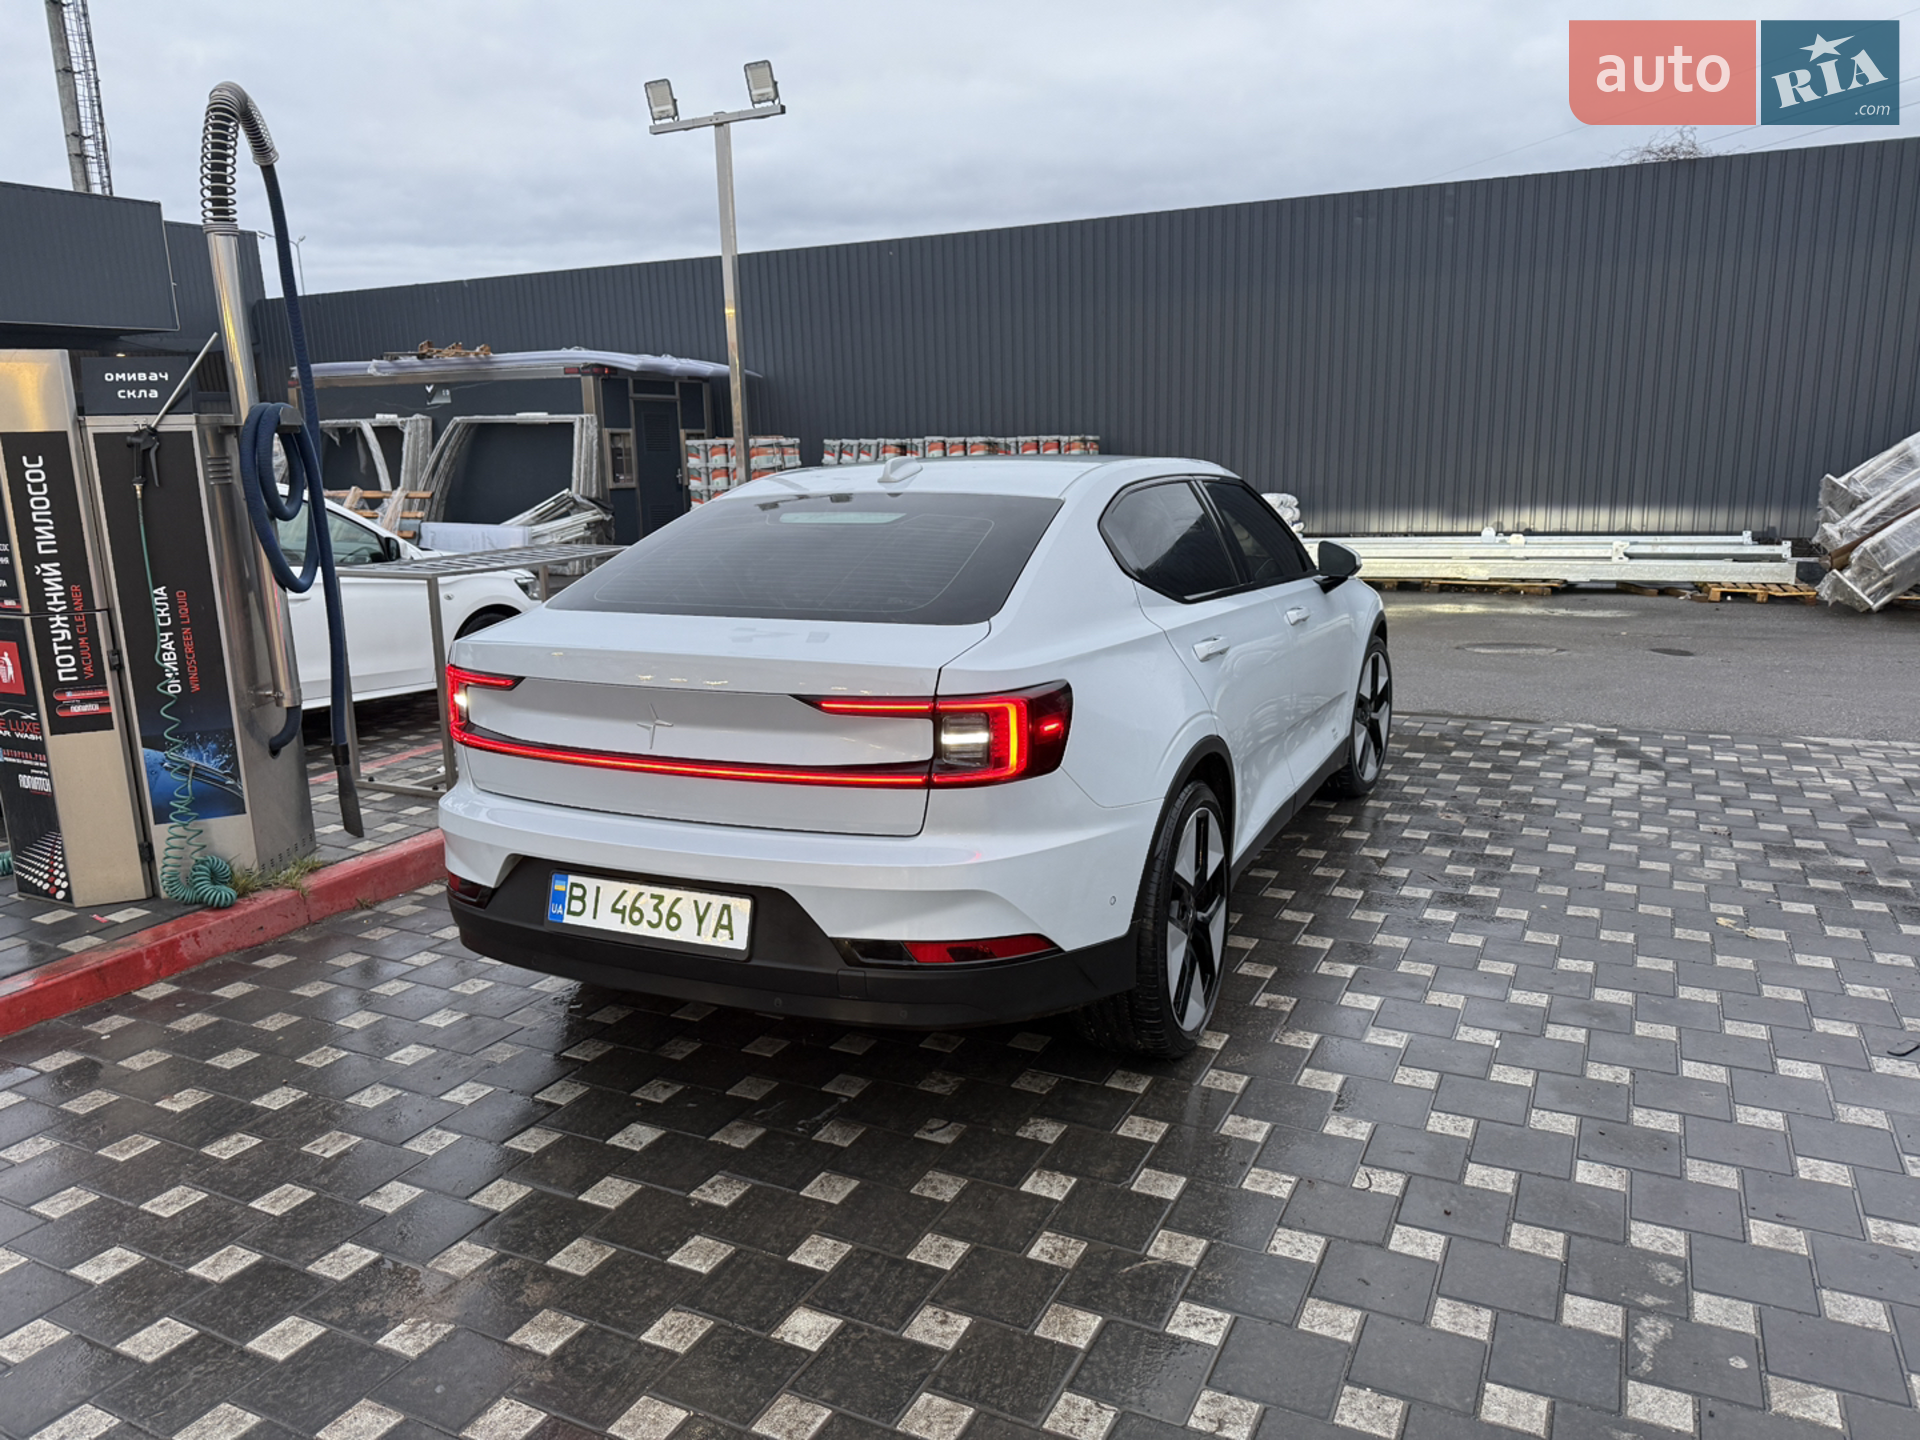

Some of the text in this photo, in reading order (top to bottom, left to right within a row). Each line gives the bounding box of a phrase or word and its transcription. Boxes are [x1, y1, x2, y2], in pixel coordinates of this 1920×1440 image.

[22, 455, 58, 554] ПИЛОСОС
[34, 562, 79, 682] ПОТУЖНИЙ
[70, 584, 88, 634] CLEANER
[153, 585, 172, 626] СКЛА
[78, 636, 94, 680] VACUUM
[176, 590, 200, 694] WINDSCREEN LIQUID
[8, 719, 41, 734] LUXE
[14, 731, 43, 741] WASH
[551, 903, 563, 915] UA
[566, 882, 734, 940] BI 4636 YA
